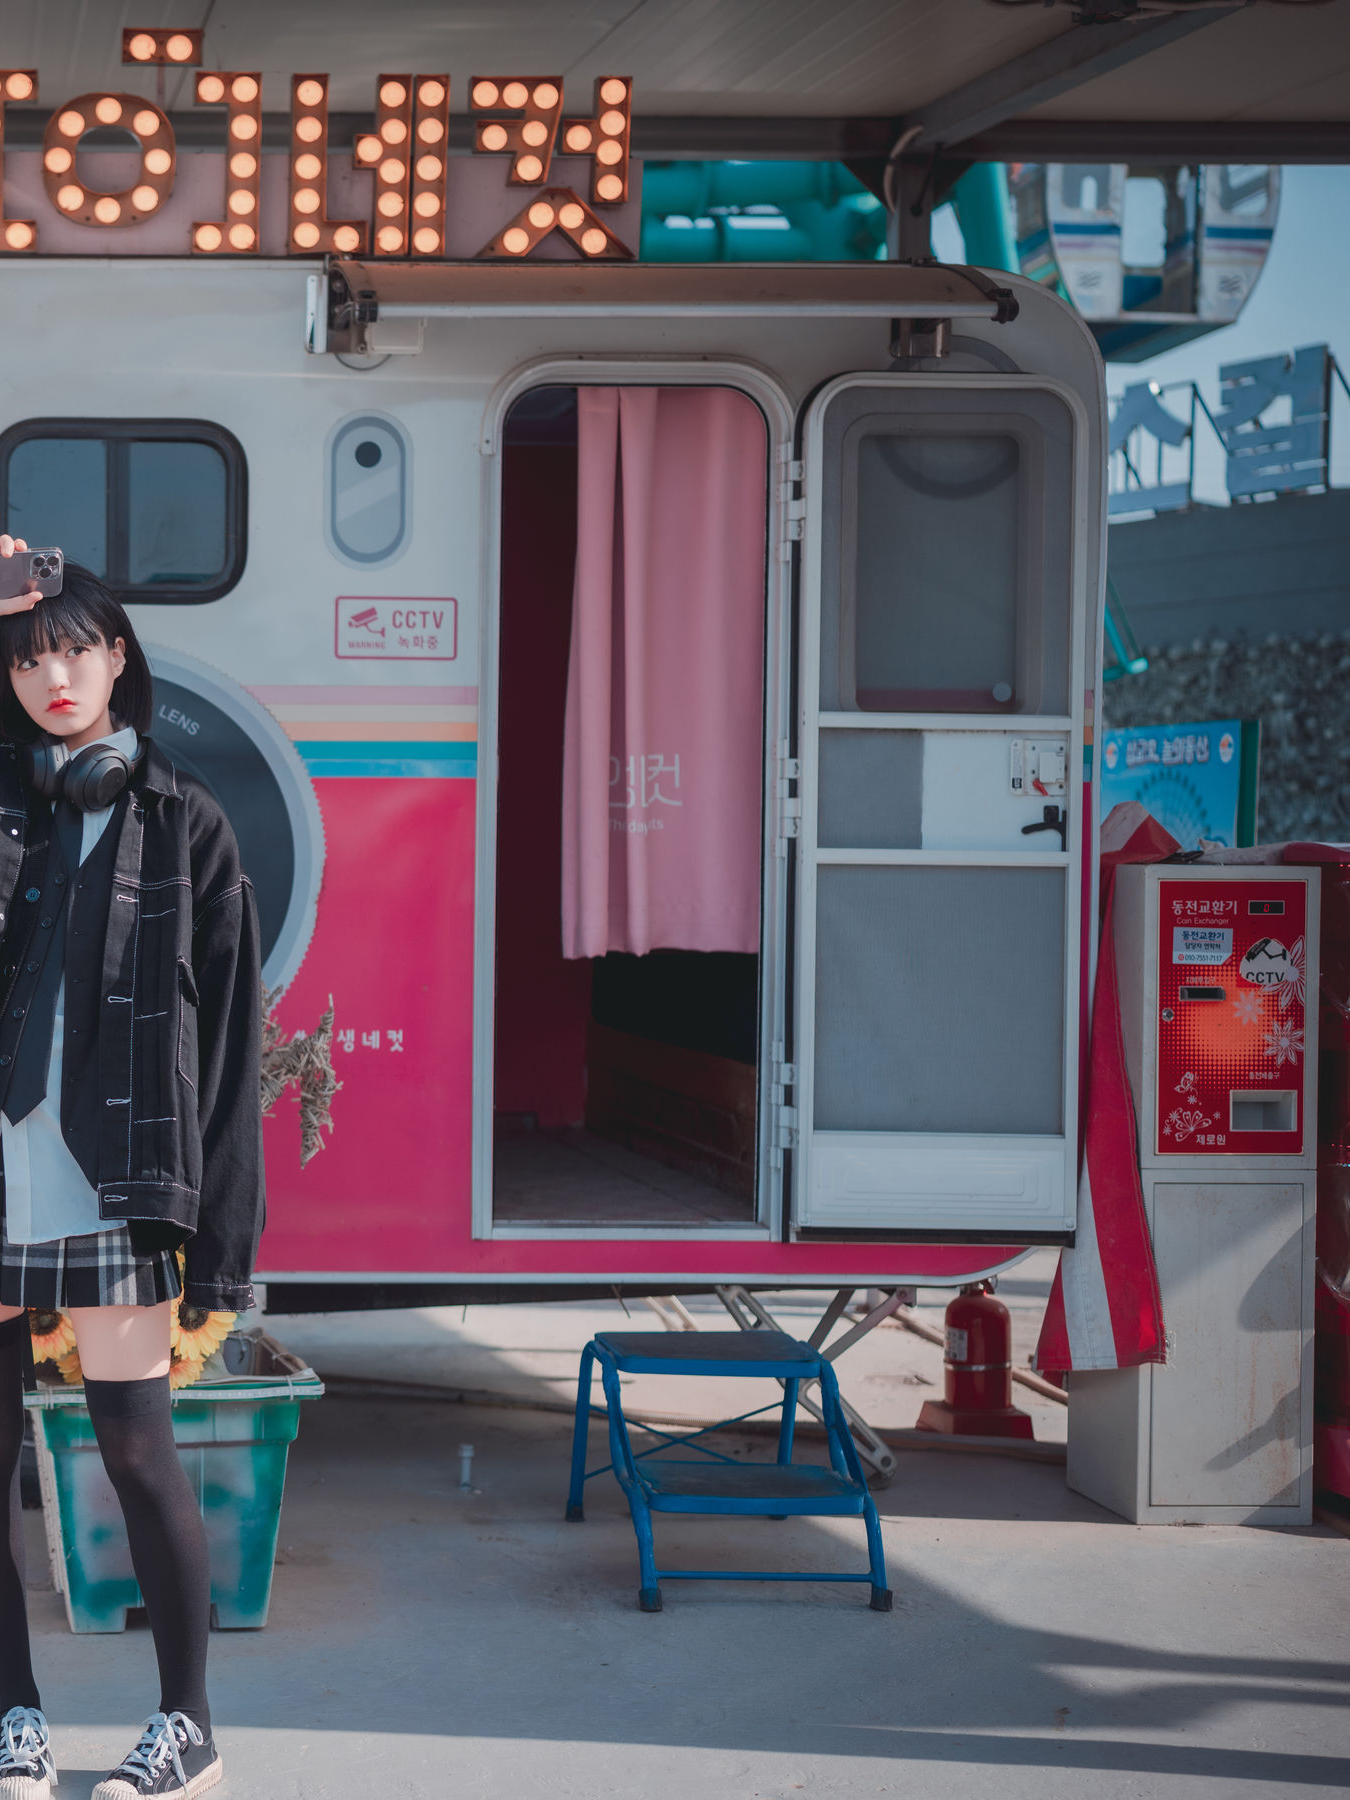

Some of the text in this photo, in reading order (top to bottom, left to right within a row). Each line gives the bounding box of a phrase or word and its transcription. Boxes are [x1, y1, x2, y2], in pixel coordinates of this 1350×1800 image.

[290, 73, 638, 259] 네컷
[392, 609, 444, 630] CCTV
[348, 640, 386, 649] WARNING
[398, 635, 439, 650] 녹화중
[158, 704, 200, 736] LENS
[1172, 900, 1238, 916] 동전교환기
[1176, 917, 1230, 926] Coin Exchanger
[1182, 930, 1225, 941] 동전교환기
[1245, 971, 1286, 985] CCTV
[1196, 1134, 1226, 1146] 제로원
